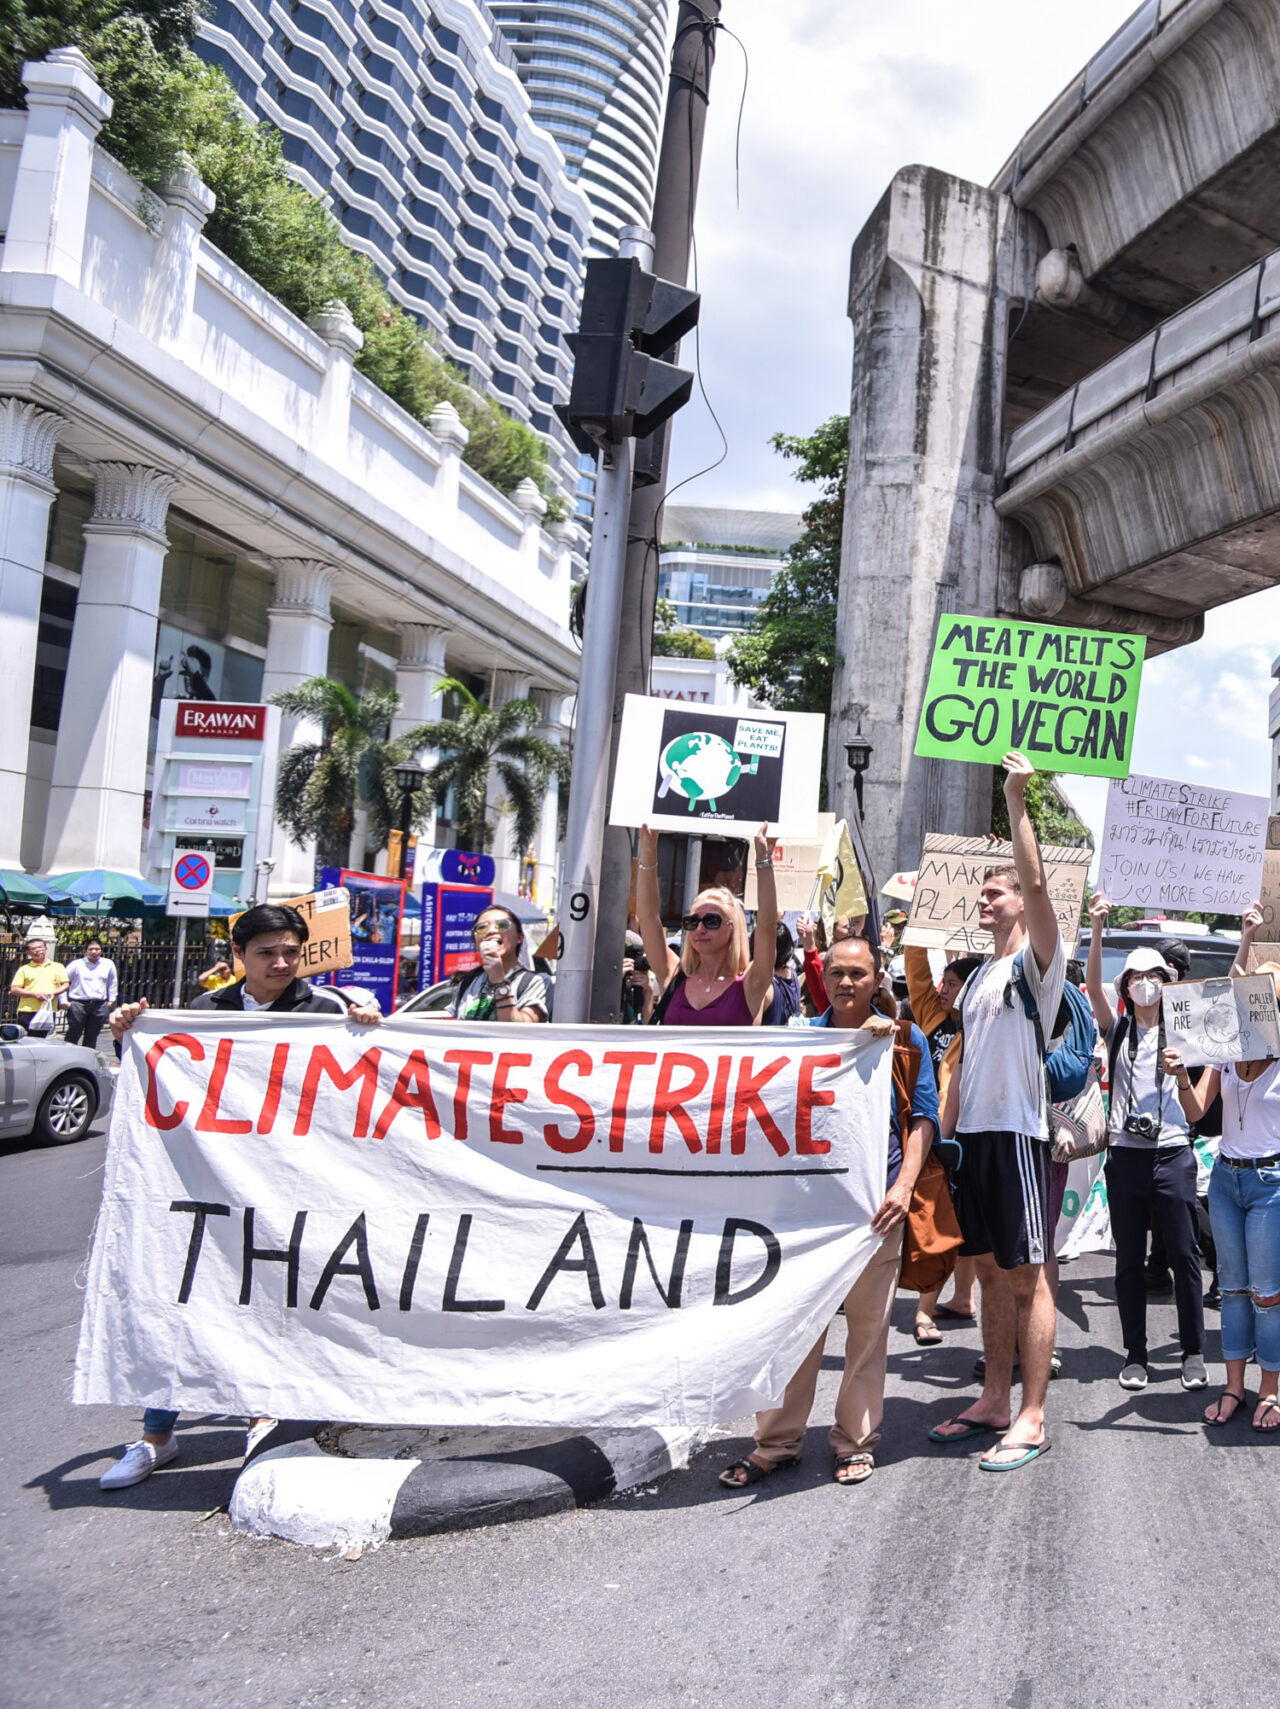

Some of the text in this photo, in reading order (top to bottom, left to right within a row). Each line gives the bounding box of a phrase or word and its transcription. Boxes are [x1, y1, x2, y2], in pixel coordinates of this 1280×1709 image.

[941, 623, 1136, 670] MEAT MELTS
[953, 658, 1127, 704] THE WORLD
[184, 710, 257, 729] ERAWAN
[925, 694, 1129, 761] GO VEGAN
[739, 725, 782, 737] SAVE ME,
[737, 740, 778, 752] PLANTS!
[1155, 859, 1186, 881] US!
[1194, 865, 1214, 880] WE
[1217, 870, 1246, 884] HAVE
[1159, 884, 1197, 904] MORE
[1202, 887, 1251, 905] SIGNS
[569, 892, 590, 922] 9
[421, 893, 433, 989] ASHTON CHULA-SILO
[1172, 1000, 1191, 1012] WE
[1249, 993, 1273, 1004] CALLED
[1173, 1015, 1192, 1031] ARE
[1249, 1010, 1277, 1023] PROTECT
[169, 1200, 783, 1313] THAILAND
